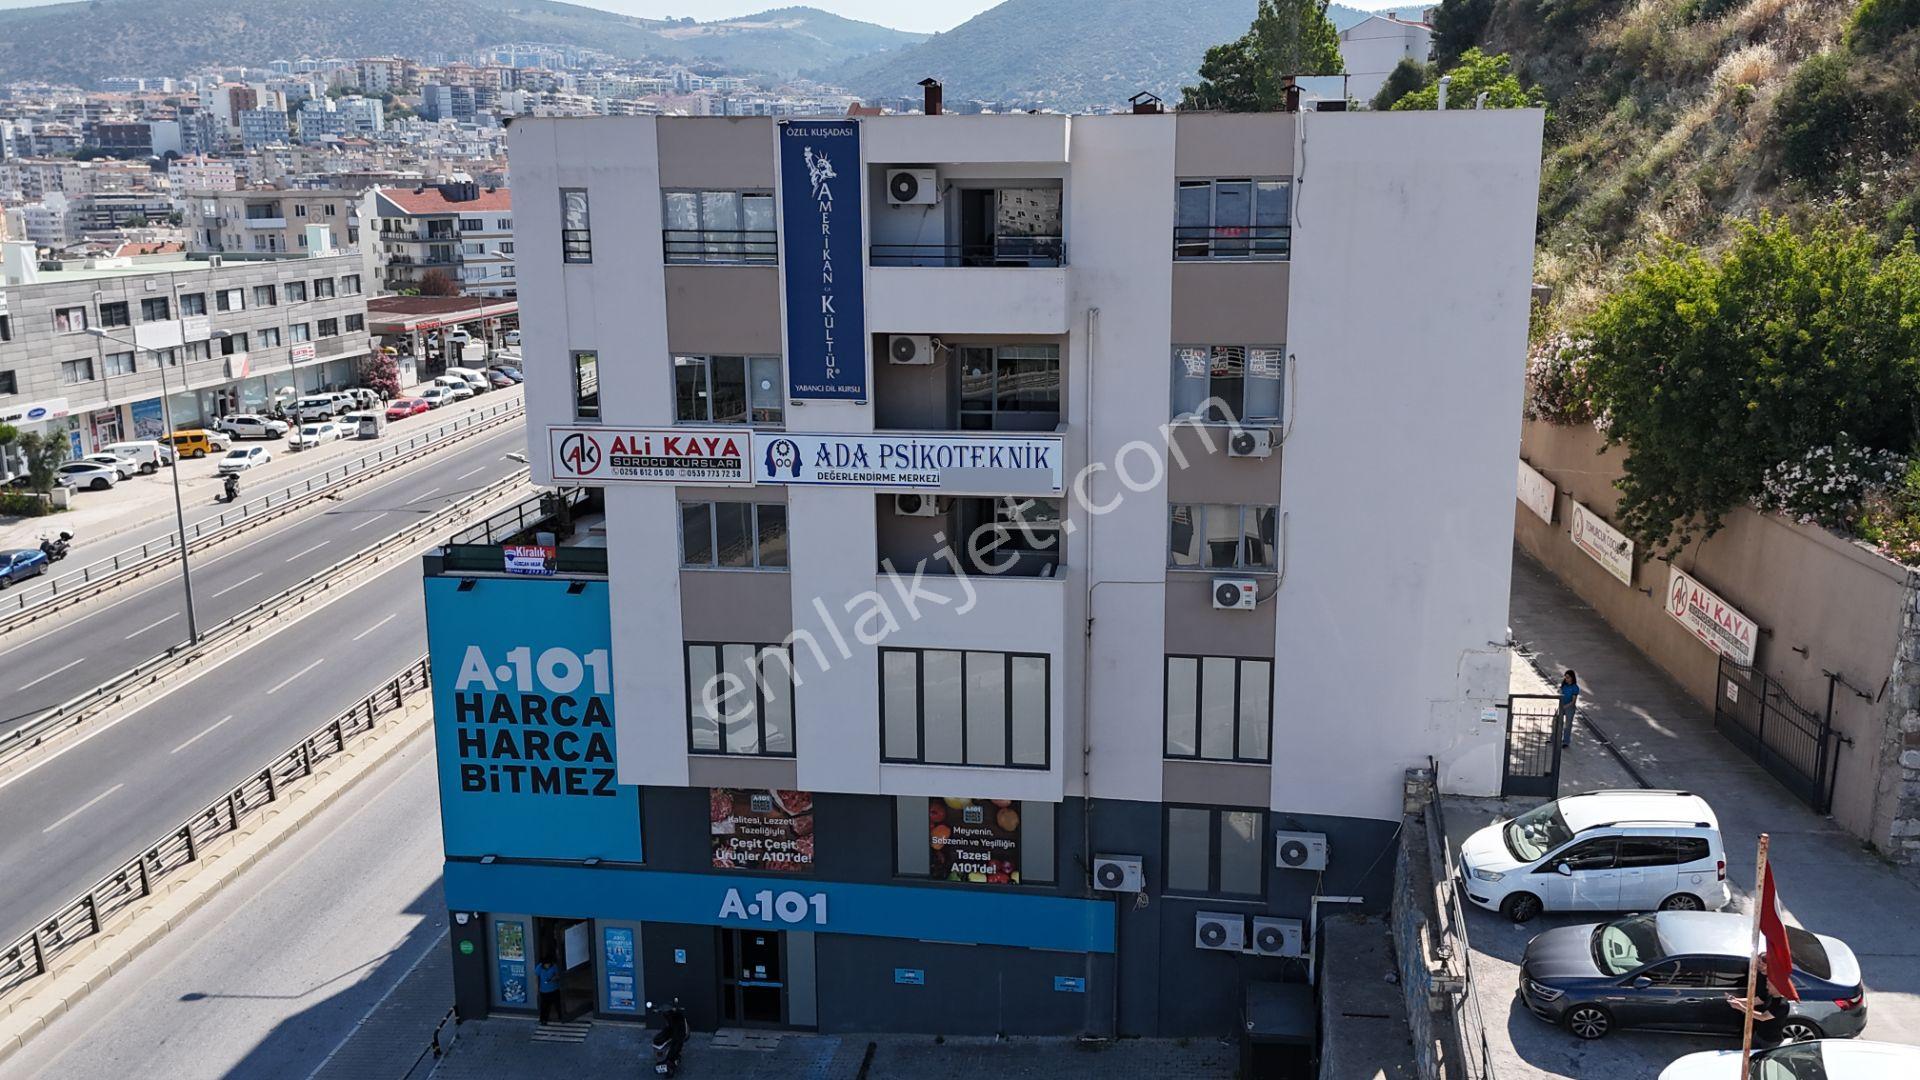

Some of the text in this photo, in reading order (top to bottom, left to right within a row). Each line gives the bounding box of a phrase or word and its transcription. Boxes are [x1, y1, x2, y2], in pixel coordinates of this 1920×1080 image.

[787, 127, 853, 138] ÖZEL KUŞADASI
[818, 182, 833, 283] AMERİKAN
[663, 437, 741, 456] KAYA
[814, 440, 1050, 469] ADA PSİKOTEKNİK
[673, 459, 738, 468] KURSLARI
[817, 471, 940, 483] DEĞERLENDİRME MERKEZİ
[516, 546, 546, 558] Kiralık
[1713, 603, 1751, 646] KAYA
[455, 692, 612, 728] HARCA
[458, 728, 614, 763] HARCA
[740, 826, 785, 836] Tazeliğiyle
[730, 837, 763, 850] Çeşit
[932, 837, 969, 846] Sebzenin
[716, 848, 812, 864] Ürünler A101'de!
[956, 850, 991, 861] Tazesi
[951, 863, 997, 874] A101'de!
